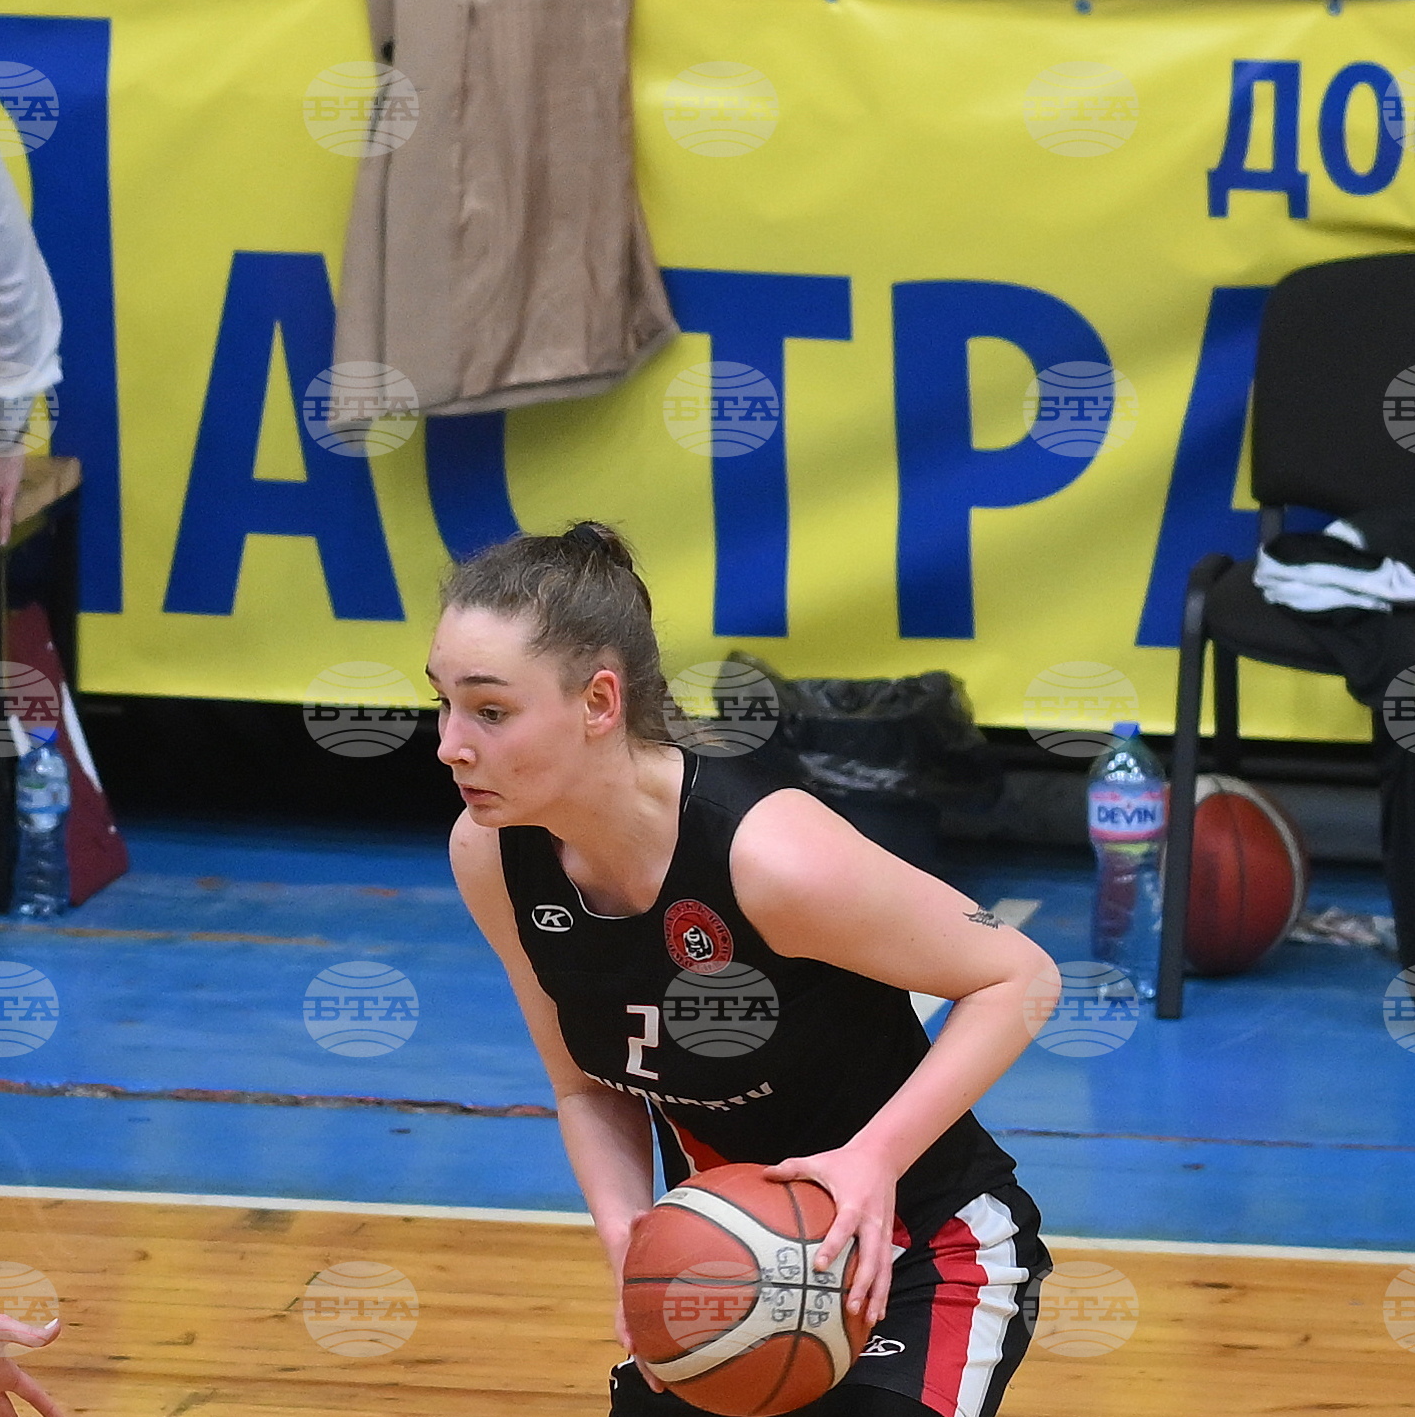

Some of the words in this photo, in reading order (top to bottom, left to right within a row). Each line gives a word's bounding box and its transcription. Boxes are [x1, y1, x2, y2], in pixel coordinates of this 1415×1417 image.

[1207, 59, 1406, 219] ДО
[1097, 805, 1157, 825] DEVIN
[626, 1004, 659, 1080] 2
